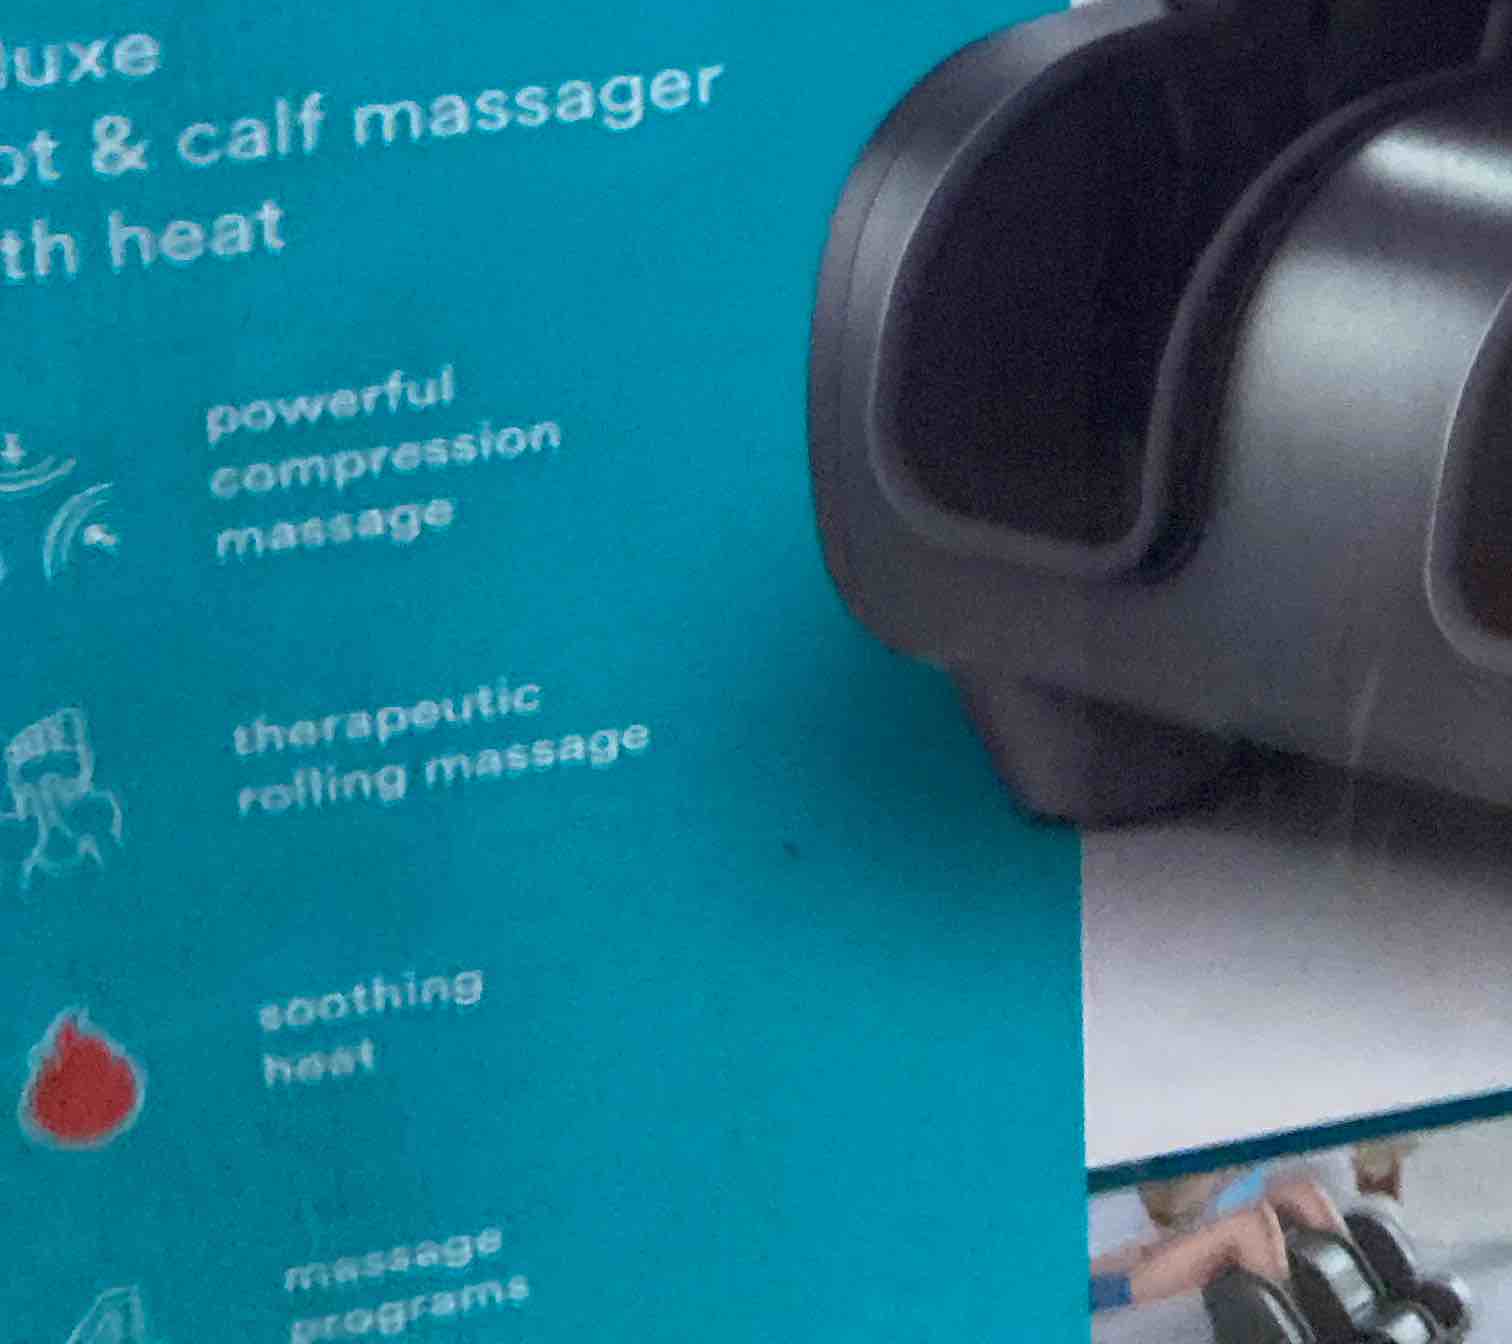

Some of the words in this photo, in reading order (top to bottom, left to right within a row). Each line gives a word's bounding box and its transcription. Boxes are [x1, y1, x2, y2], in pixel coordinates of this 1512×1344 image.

[91, 115, 150, 177] &
[177, 92, 326, 167] calf
[354, 62, 726, 148] massager
[107, 200, 286, 272] heat
[206, 364, 456, 447] powerful
[210, 420, 561, 499] compression
[216, 498, 456, 562] massage
[232, 677, 543, 757] therapeutic
[238, 761, 408, 816] rolling
[424, 721, 650, 785] massage
[258, 967, 485, 1034] soothing
[263, 1037, 375, 1088] heat
[285, 1225, 503, 1292] massage
[291, 1274, 530, 1344] programs
